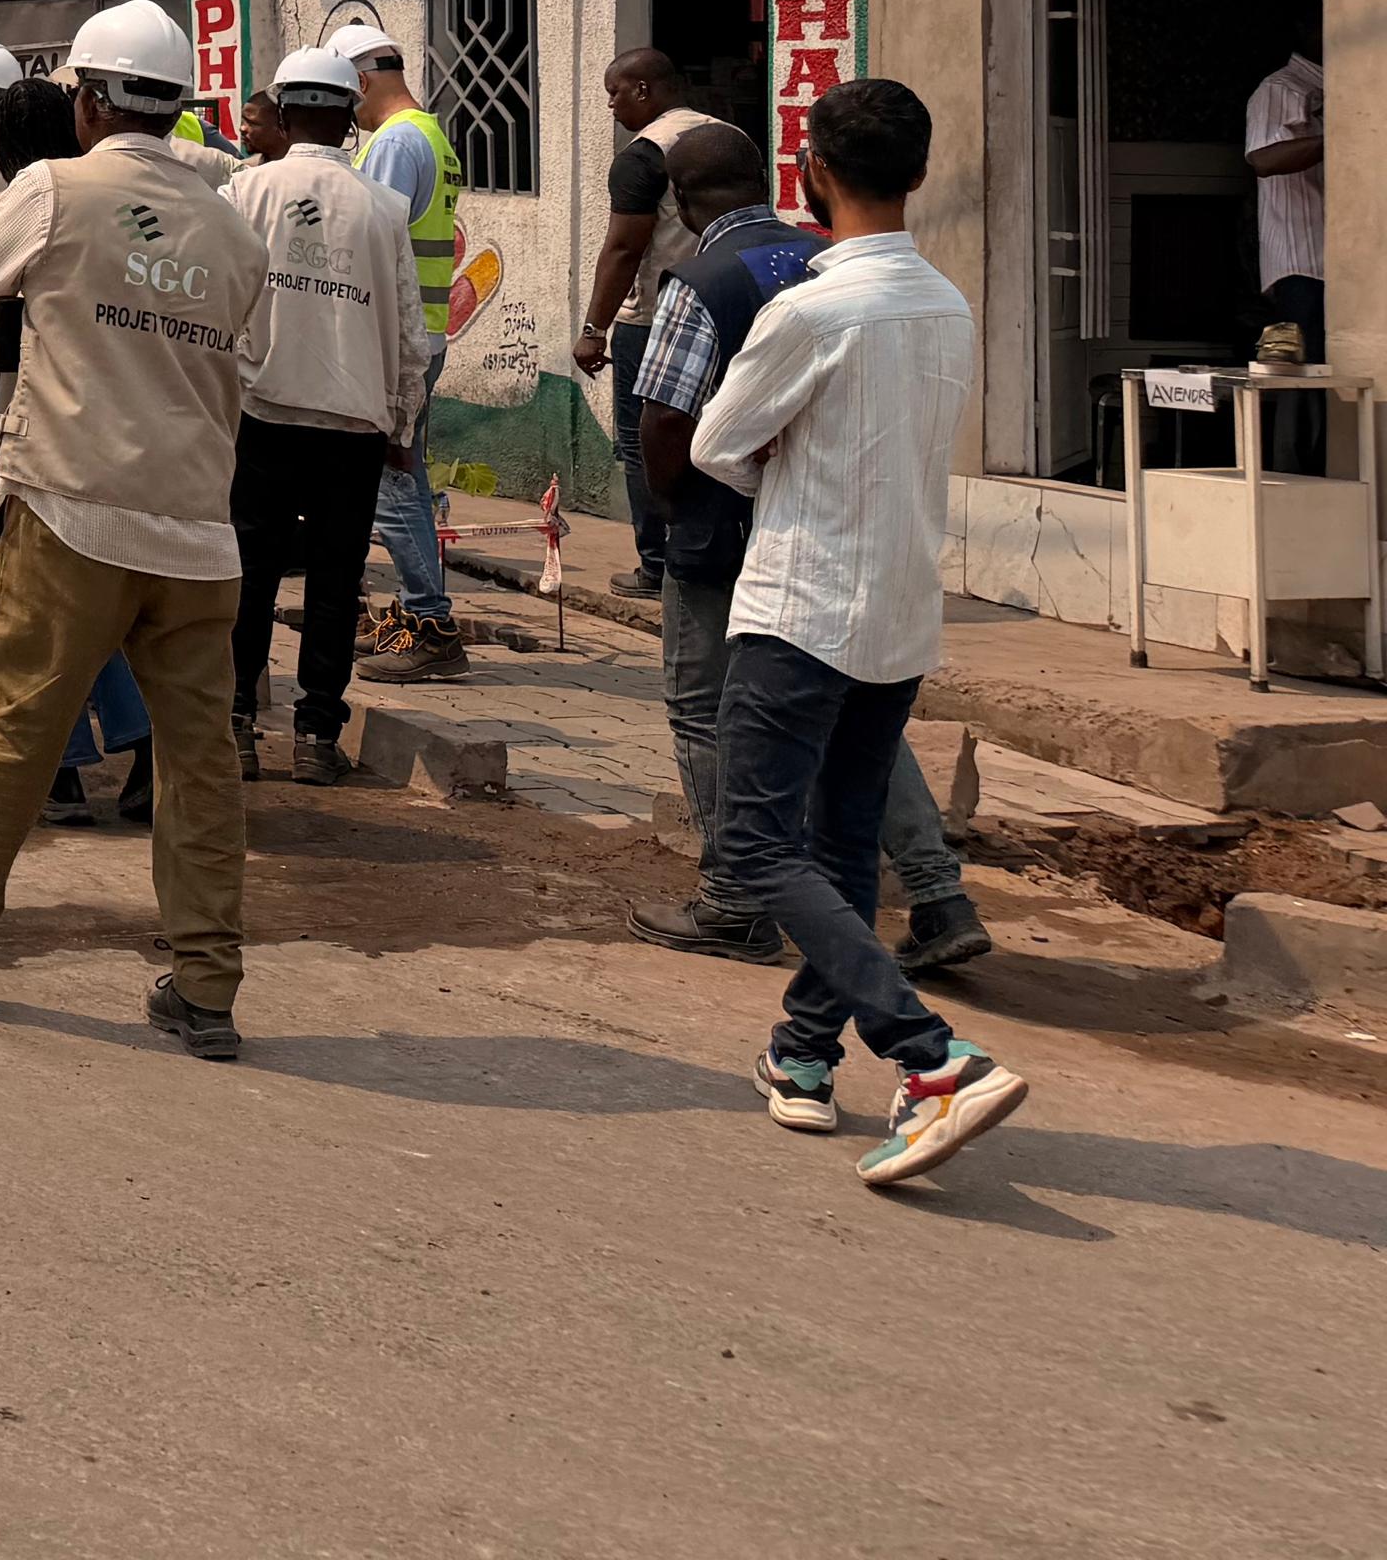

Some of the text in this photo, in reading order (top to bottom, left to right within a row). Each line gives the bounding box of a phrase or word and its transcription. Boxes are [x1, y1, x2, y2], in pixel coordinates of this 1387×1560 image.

[124, 251, 209, 301] SGC
[287, 237, 354, 276] SGC
[268, 272, 371, 307] PROJET TOPETOLA
[96, 303, 235, 354] PROJET TOPETOLA
